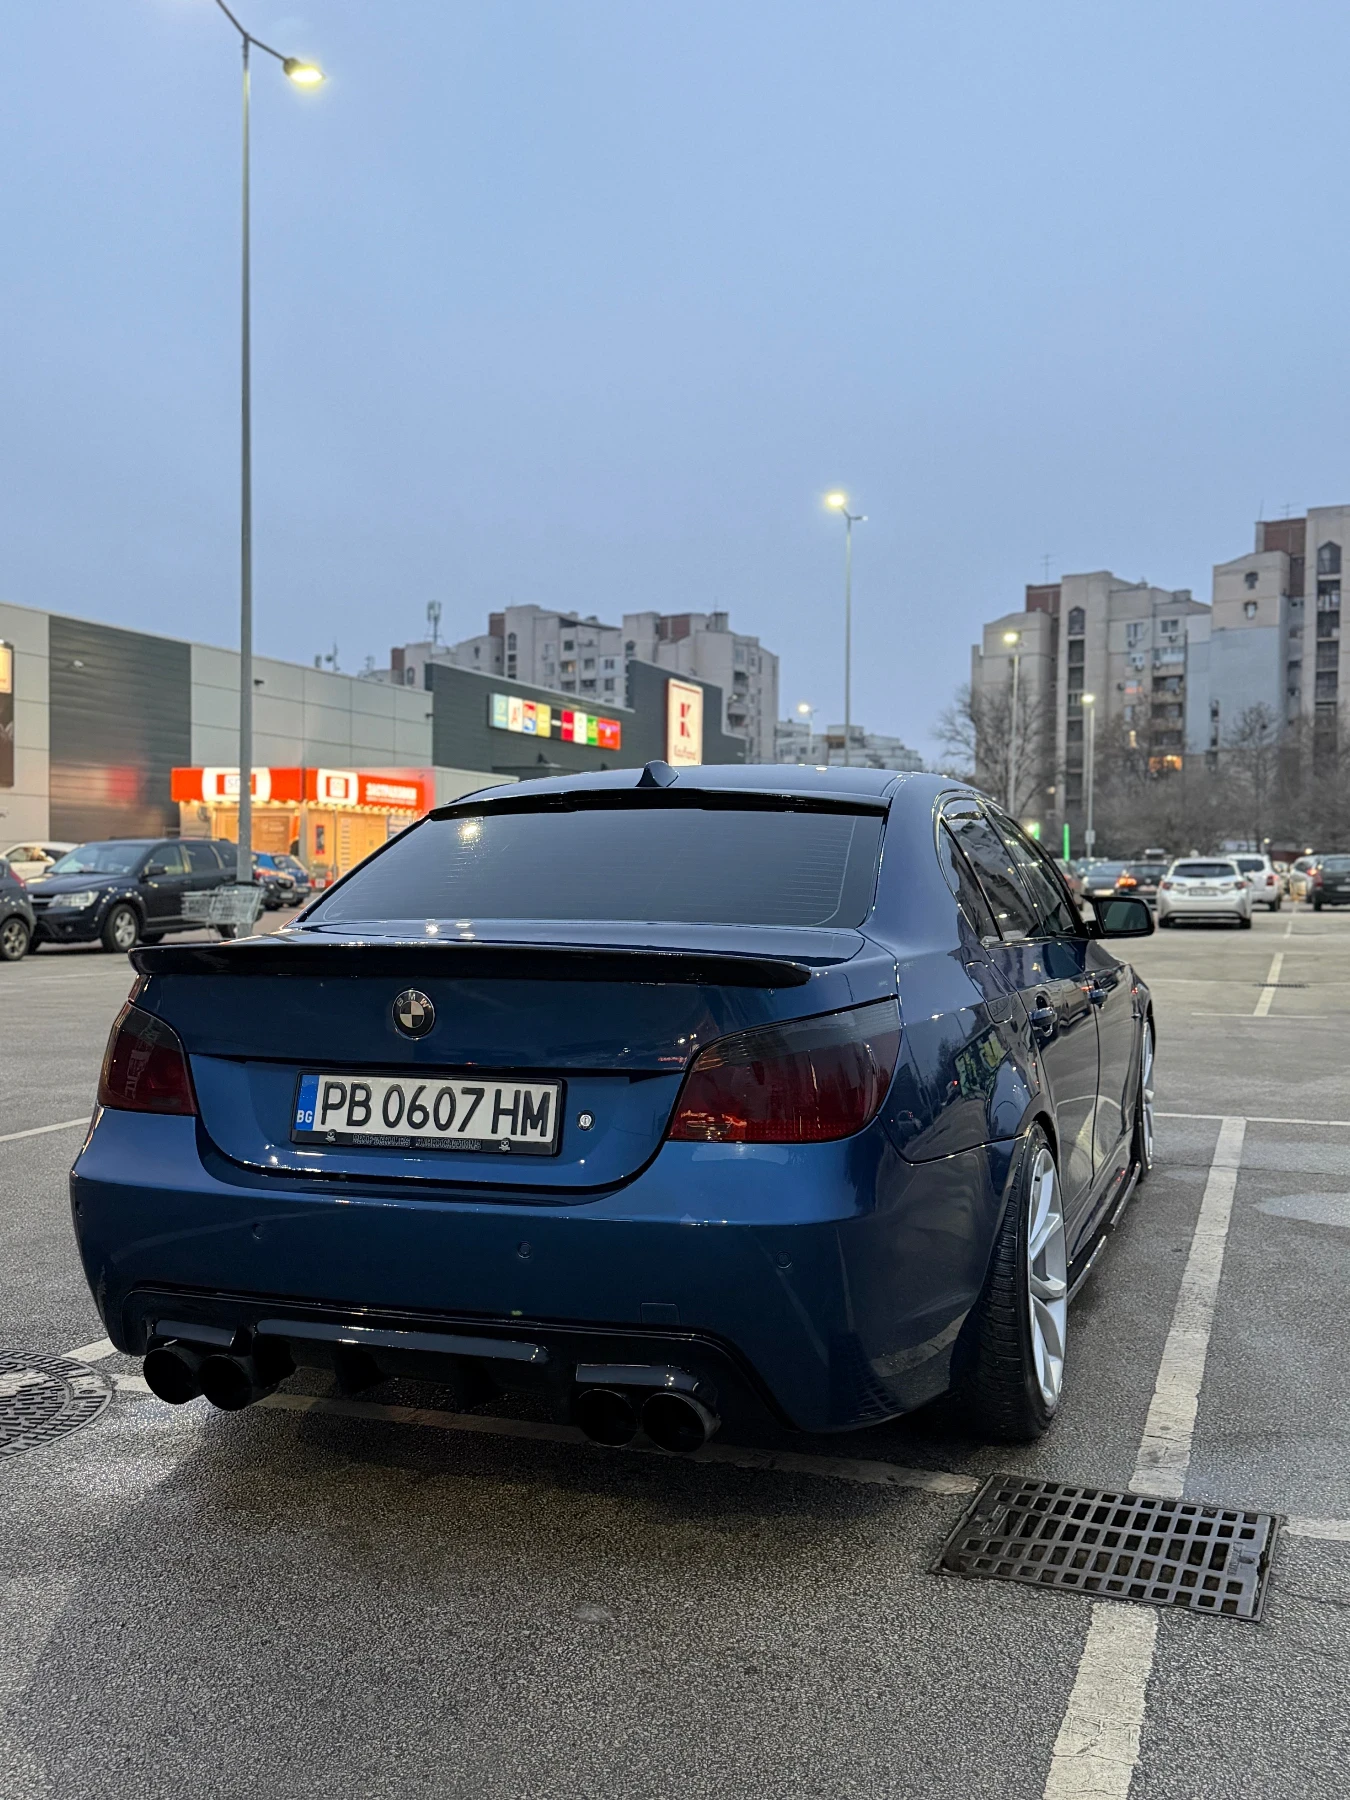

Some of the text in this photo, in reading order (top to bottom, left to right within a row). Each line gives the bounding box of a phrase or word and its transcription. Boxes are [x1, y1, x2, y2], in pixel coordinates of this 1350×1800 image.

[680, 702, 691, 739] K
[396, 992, 430, 1008] BMW
[296, 1109, 313, 1124] BG
[320, 1080, 551, 1138] PB 0607 HM
